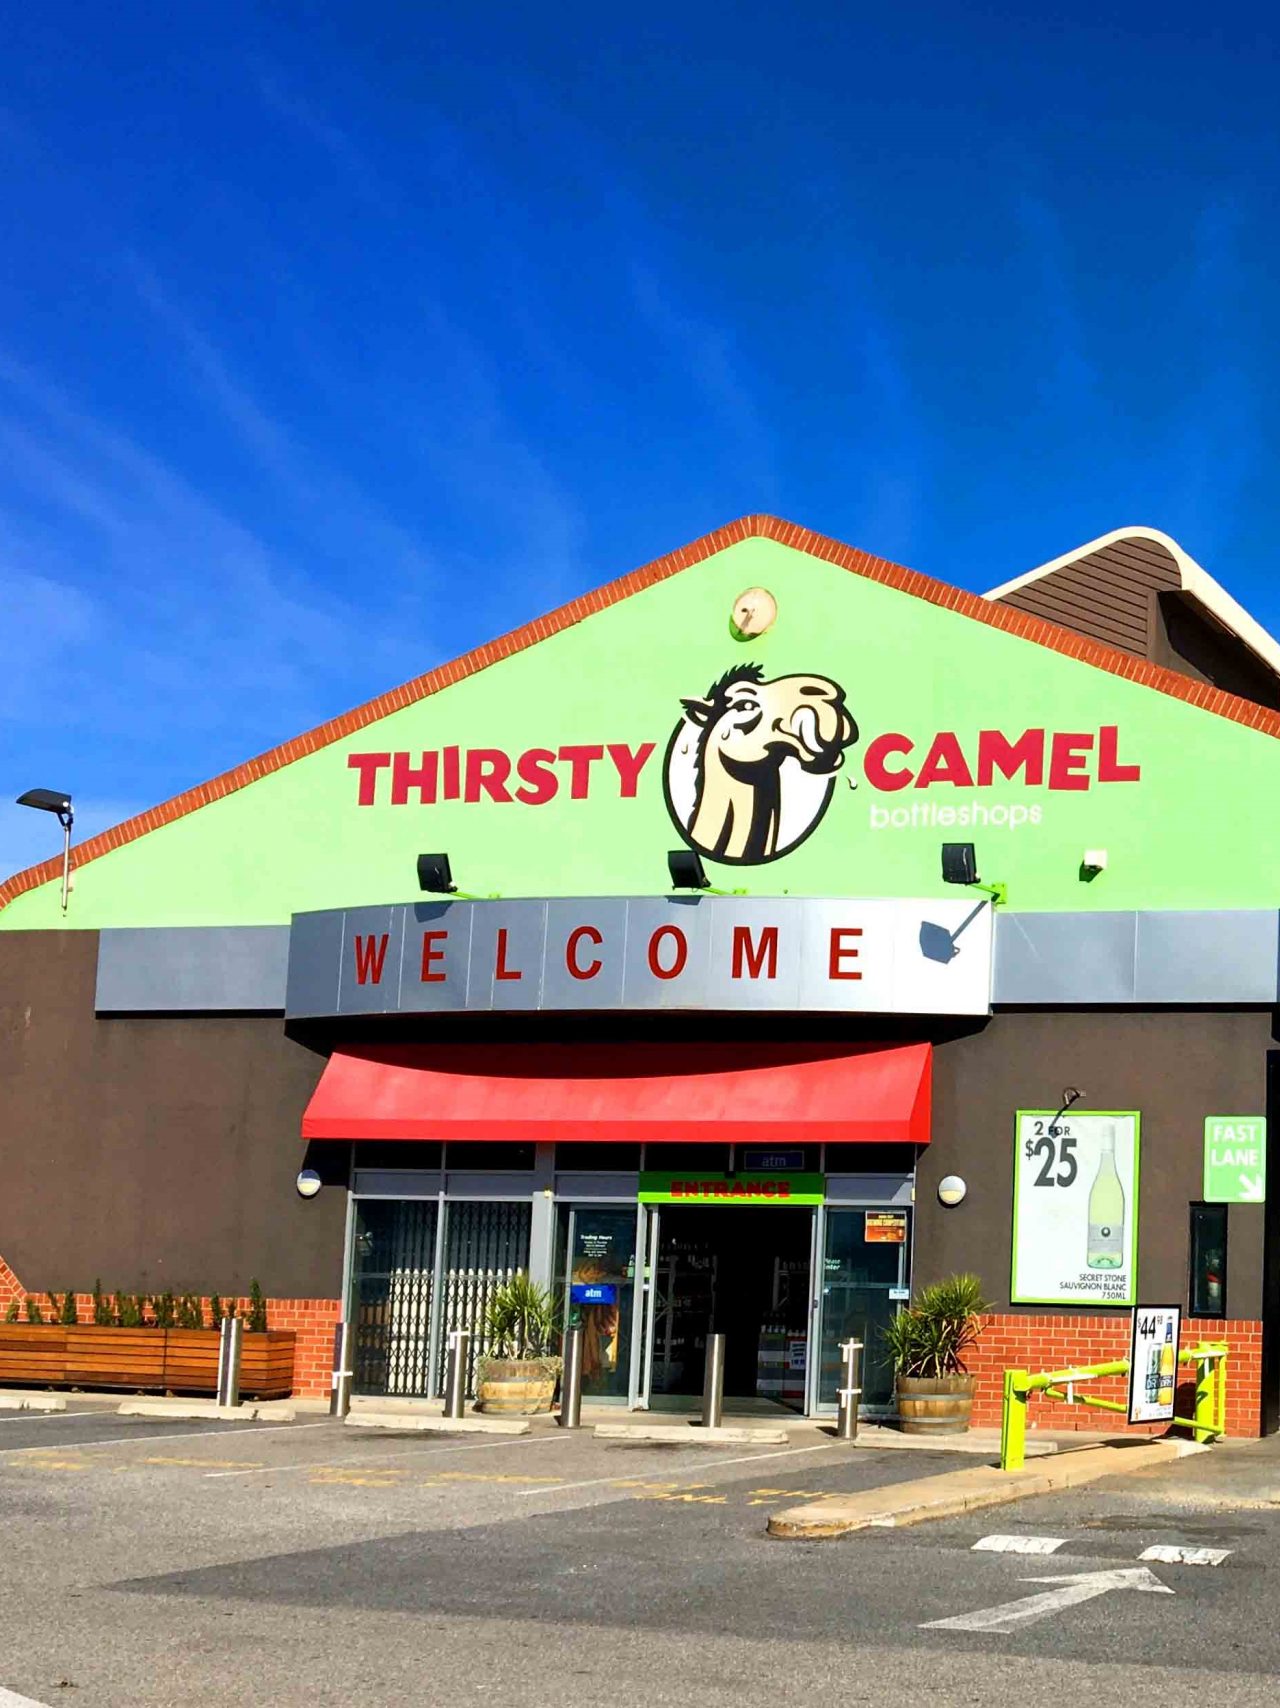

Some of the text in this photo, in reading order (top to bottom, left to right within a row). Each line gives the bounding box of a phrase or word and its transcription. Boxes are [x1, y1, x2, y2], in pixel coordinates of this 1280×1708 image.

[347, 726, 1141, 807] THIRSTY CAMEL
[869, 802, 1043, 831] bottleshops
[354, 925, 865, 985] WELCOME
[1034, 1121, 1044, 1136] 2
[1213, 1125, 1257, 1142] FAST
[761, 1155, 787, 1167] atm
[1025, 1137, 1078, 1188] $25
[1210, 1149, 1258, 1166] LANE
[670, 1181, 791, 1198] ENTRANCE
[1079, 1273, 1127, 1282] SECRET STONE
[585, 1289, 602, 1298] atm
[1059, 1282, 1127, 1291] SAUVIGNON BLANC
